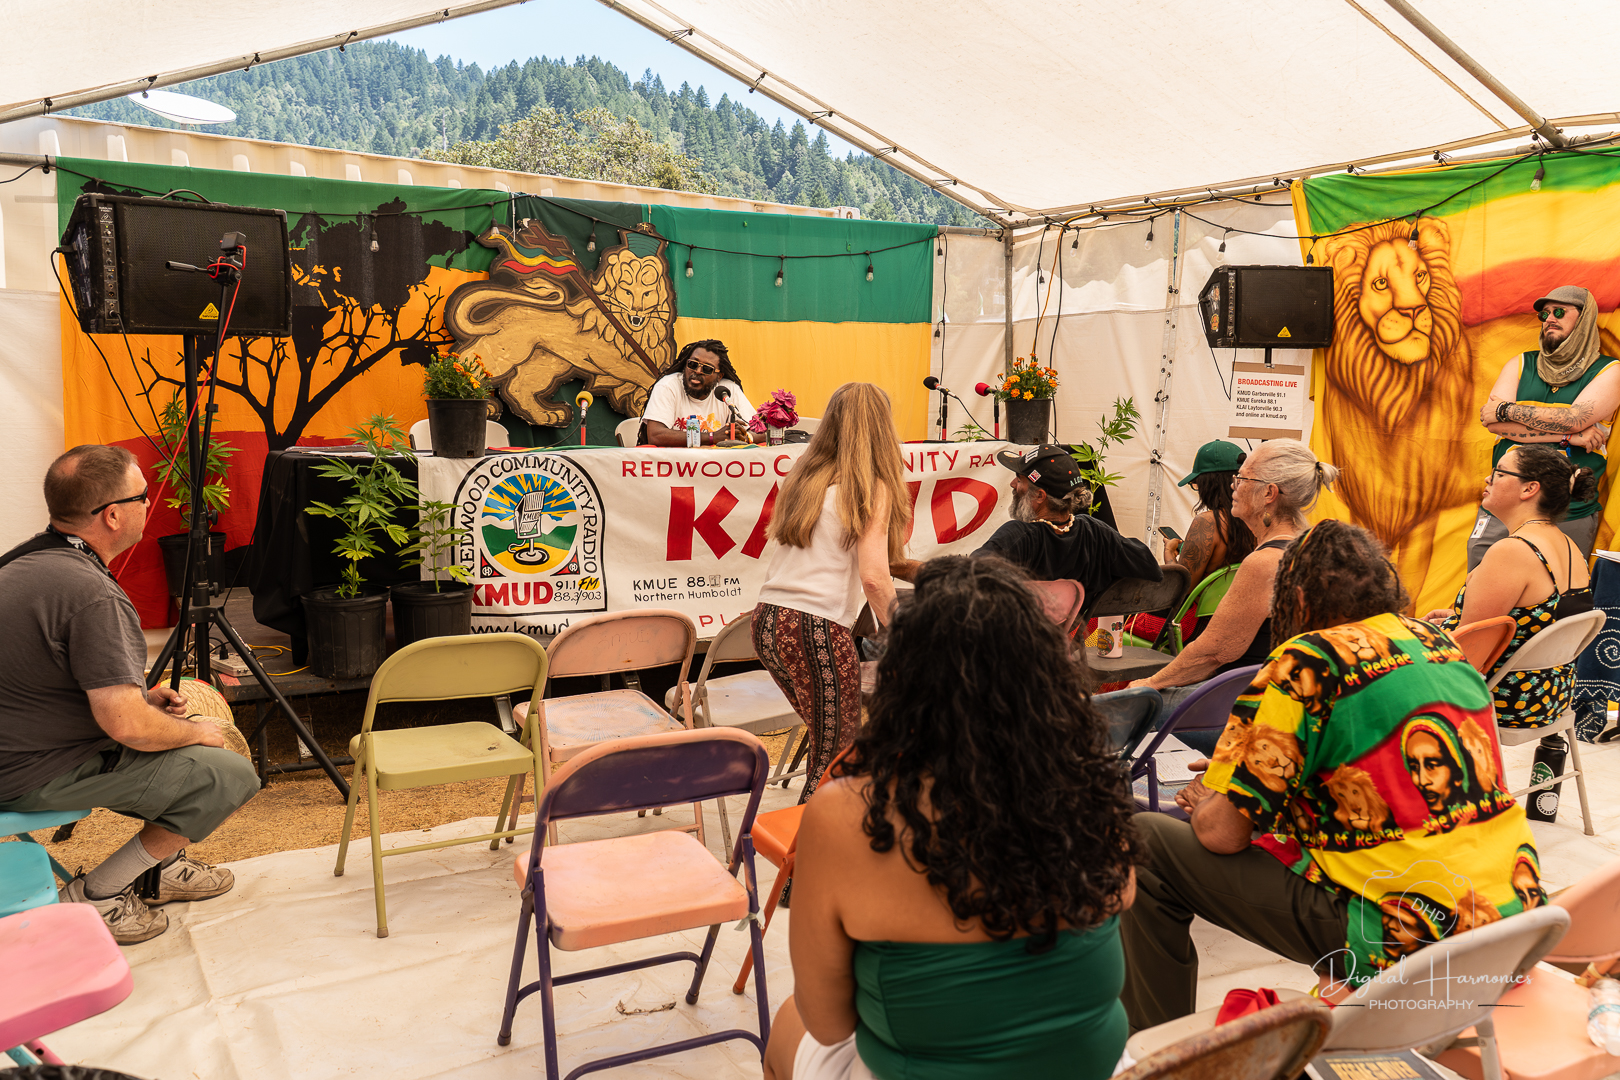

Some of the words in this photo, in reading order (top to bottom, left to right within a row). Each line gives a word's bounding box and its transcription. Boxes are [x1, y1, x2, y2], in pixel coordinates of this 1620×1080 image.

[1238, 378, 1283, 387] BROADCASTING
[622, 460, 766, 478] REDWOOD
[489, 456, 596, 511] COMMUNITY
[583, 514, 598, 574] RADIO
[555, 579, 577, 591] 91.1
[577, 576, 600, 592] FM
[633, 577, 678, 590] KMUE
[724, 577, 740, 586] FM
[634, 590, 685, 602] Northern
[688, 587, 742, 599] Humboldt
[1344, 666, 1361, 686] of
[1360, 652, 1414, 678] Reggae
[1334, 831, 1349, 847] of
